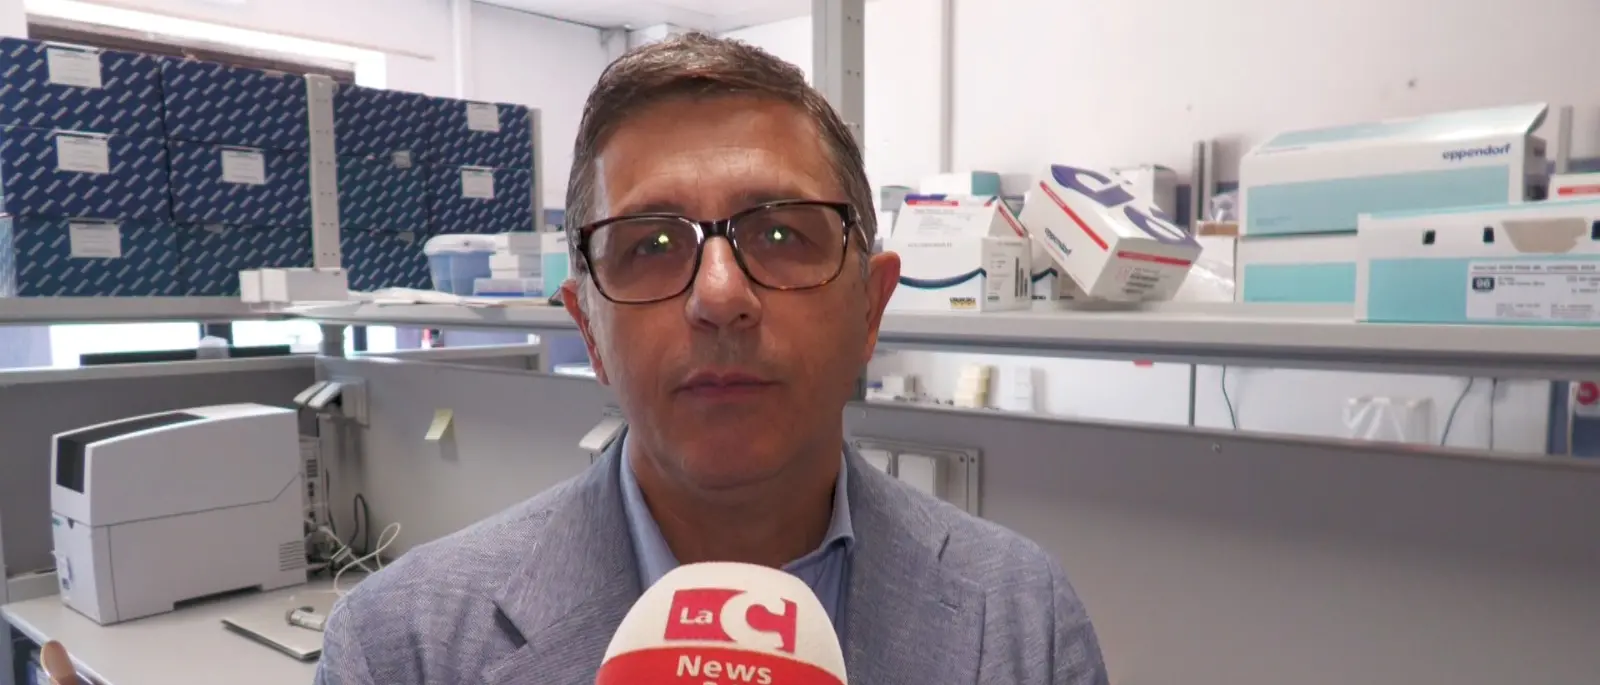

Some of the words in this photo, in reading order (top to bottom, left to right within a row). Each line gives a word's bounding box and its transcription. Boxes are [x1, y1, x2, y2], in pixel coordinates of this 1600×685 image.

[1442, 143, 1511, 161] eppendorf
[679, 606, 714, 625] La
[719, 588, 788, 651] C
[676, 655, 773, 684] News
